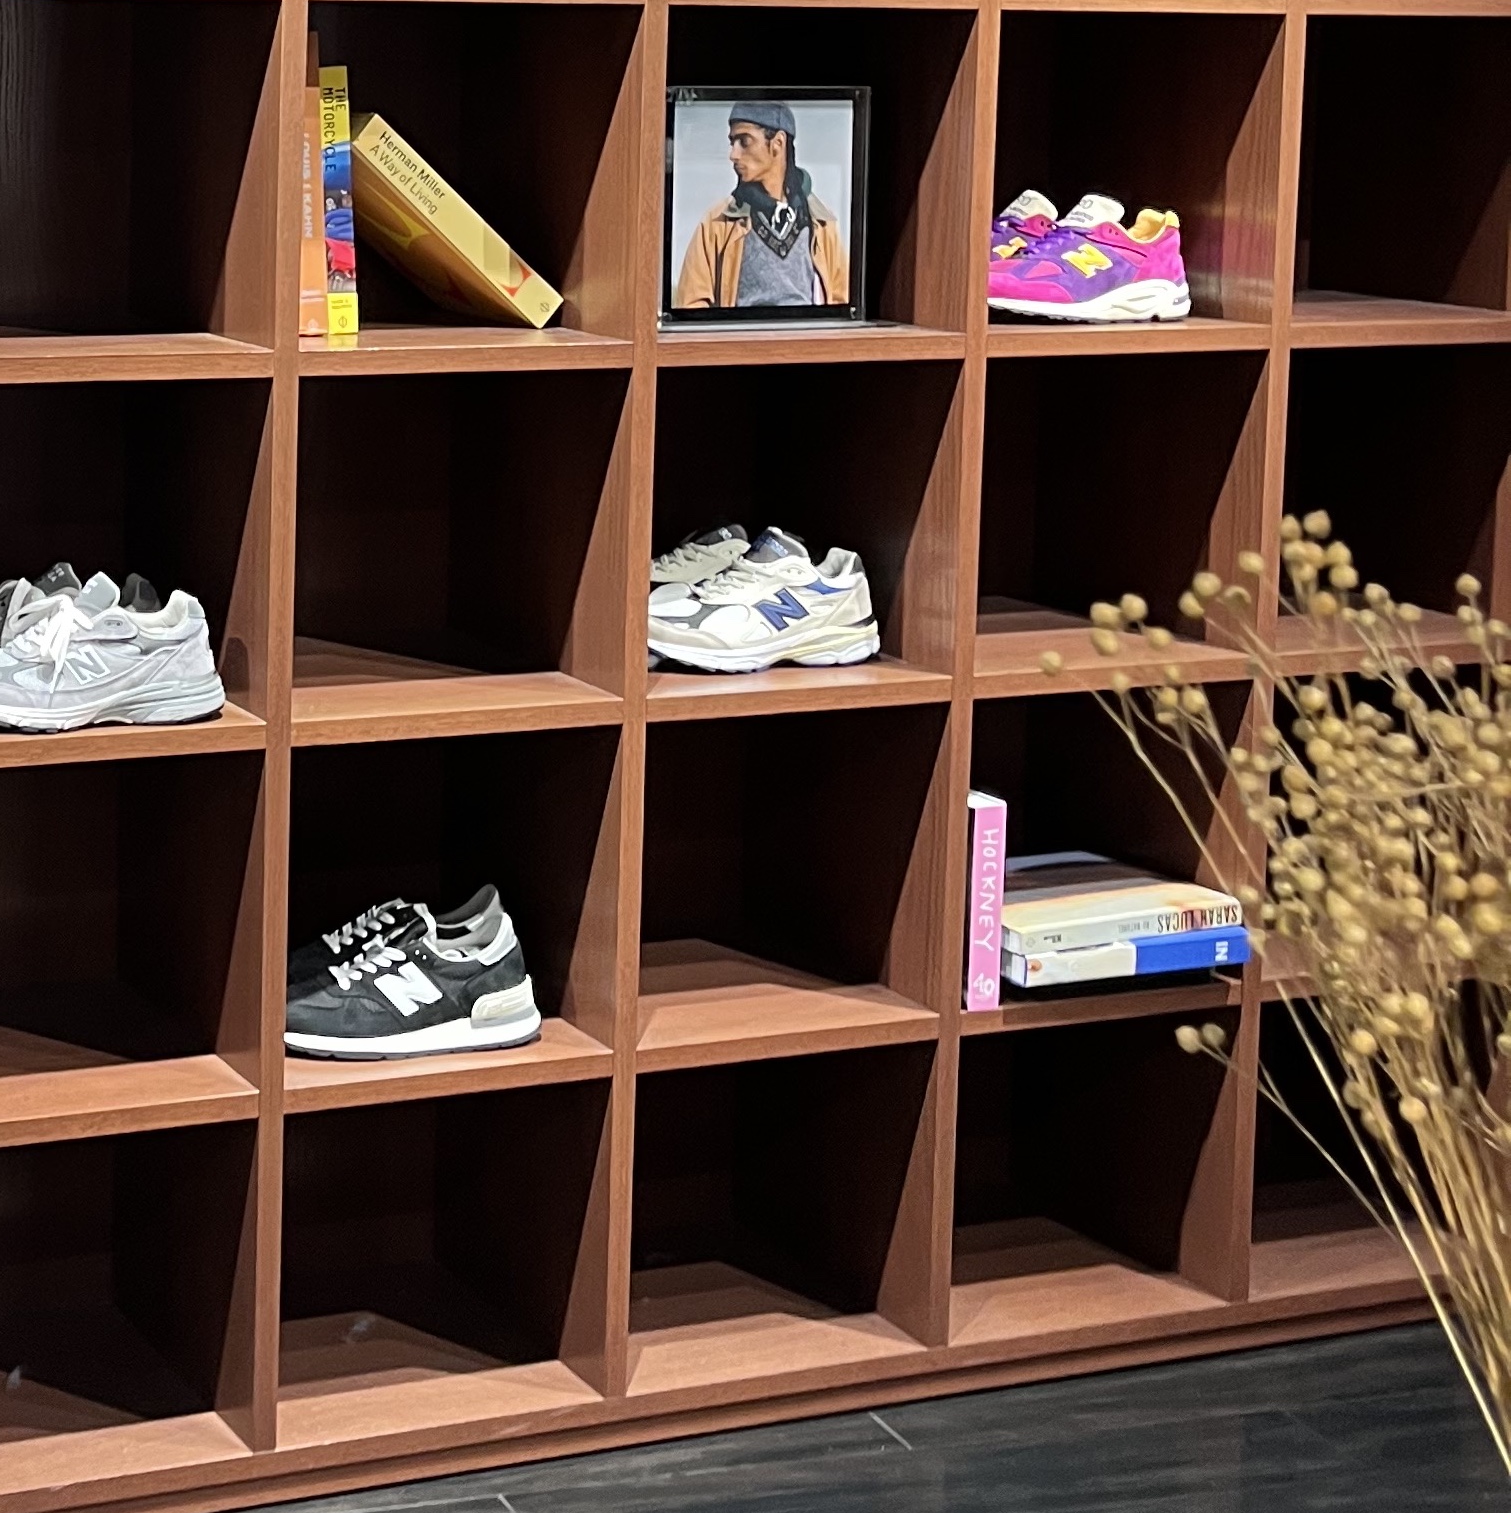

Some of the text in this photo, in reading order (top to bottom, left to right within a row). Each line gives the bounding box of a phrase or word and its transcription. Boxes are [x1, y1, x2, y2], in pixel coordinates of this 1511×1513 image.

[334, 87, 347, 112] THE
[322, 87, 337, 172] MOTORCYCLE
[369, 144, 438, 215] A Way of Living
[379, 130, 446, 199] Herman Miller
[1060, 243, 1114, 278] N
[752, 587, 810, 632] N
[974, 827, 1000, 953] HOCKNEY
[1200, 904, 1239, 927] SARAH
[1157, 908, 1194, 933] LUCAS
[373, 960, 444, 1017] N
